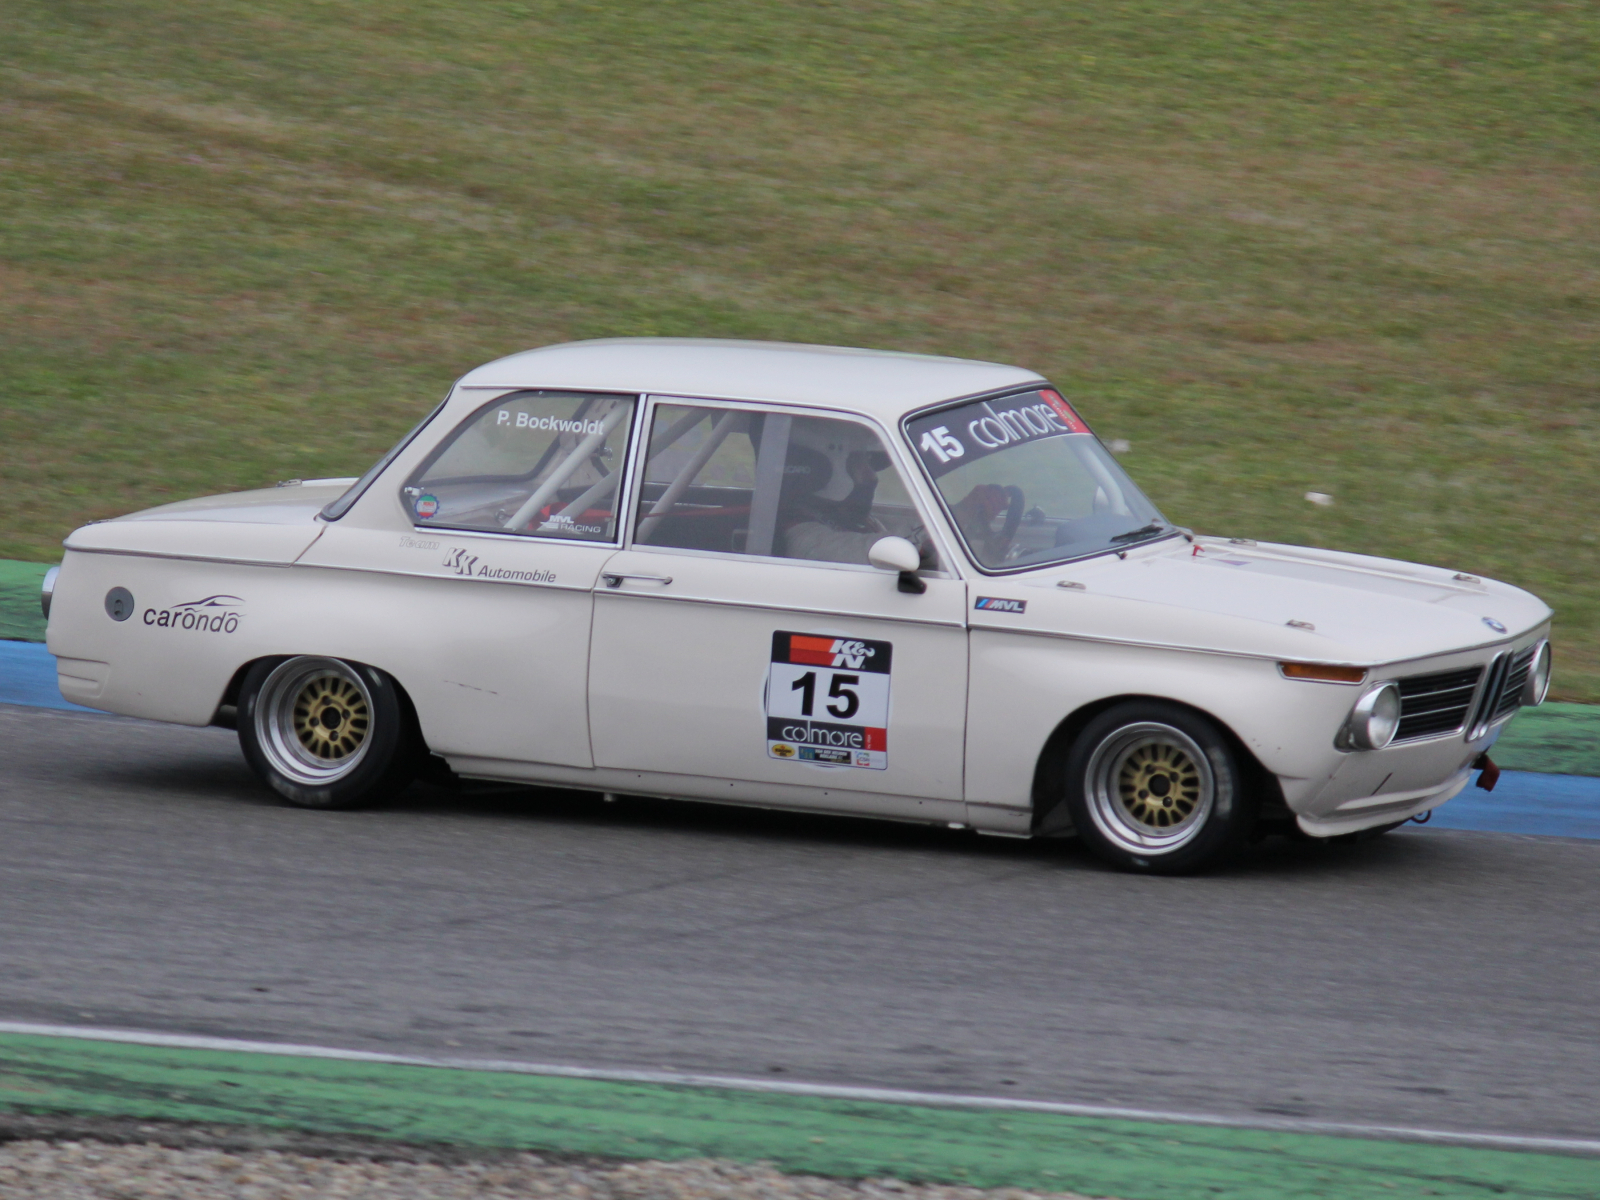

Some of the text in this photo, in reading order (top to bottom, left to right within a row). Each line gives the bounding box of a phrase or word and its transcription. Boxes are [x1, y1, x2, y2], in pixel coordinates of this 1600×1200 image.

[496, 409, 605, 435] P. Bockwoldt
[920, 425, 965, 463] 15
[968, 401, 1069, 448] colmore
[549, 515, 575, 524] MVL
[560, 523, 602, 533] RACING
[398, 535, 441, 550] Team
[442, 546, 479, 576] KK
[477, 564, 557, 583] Automobile
[989, 599, 1024, 611] MVL
[791, 671, 860, 719] 15
[782, 719, 863, 748] colmore
